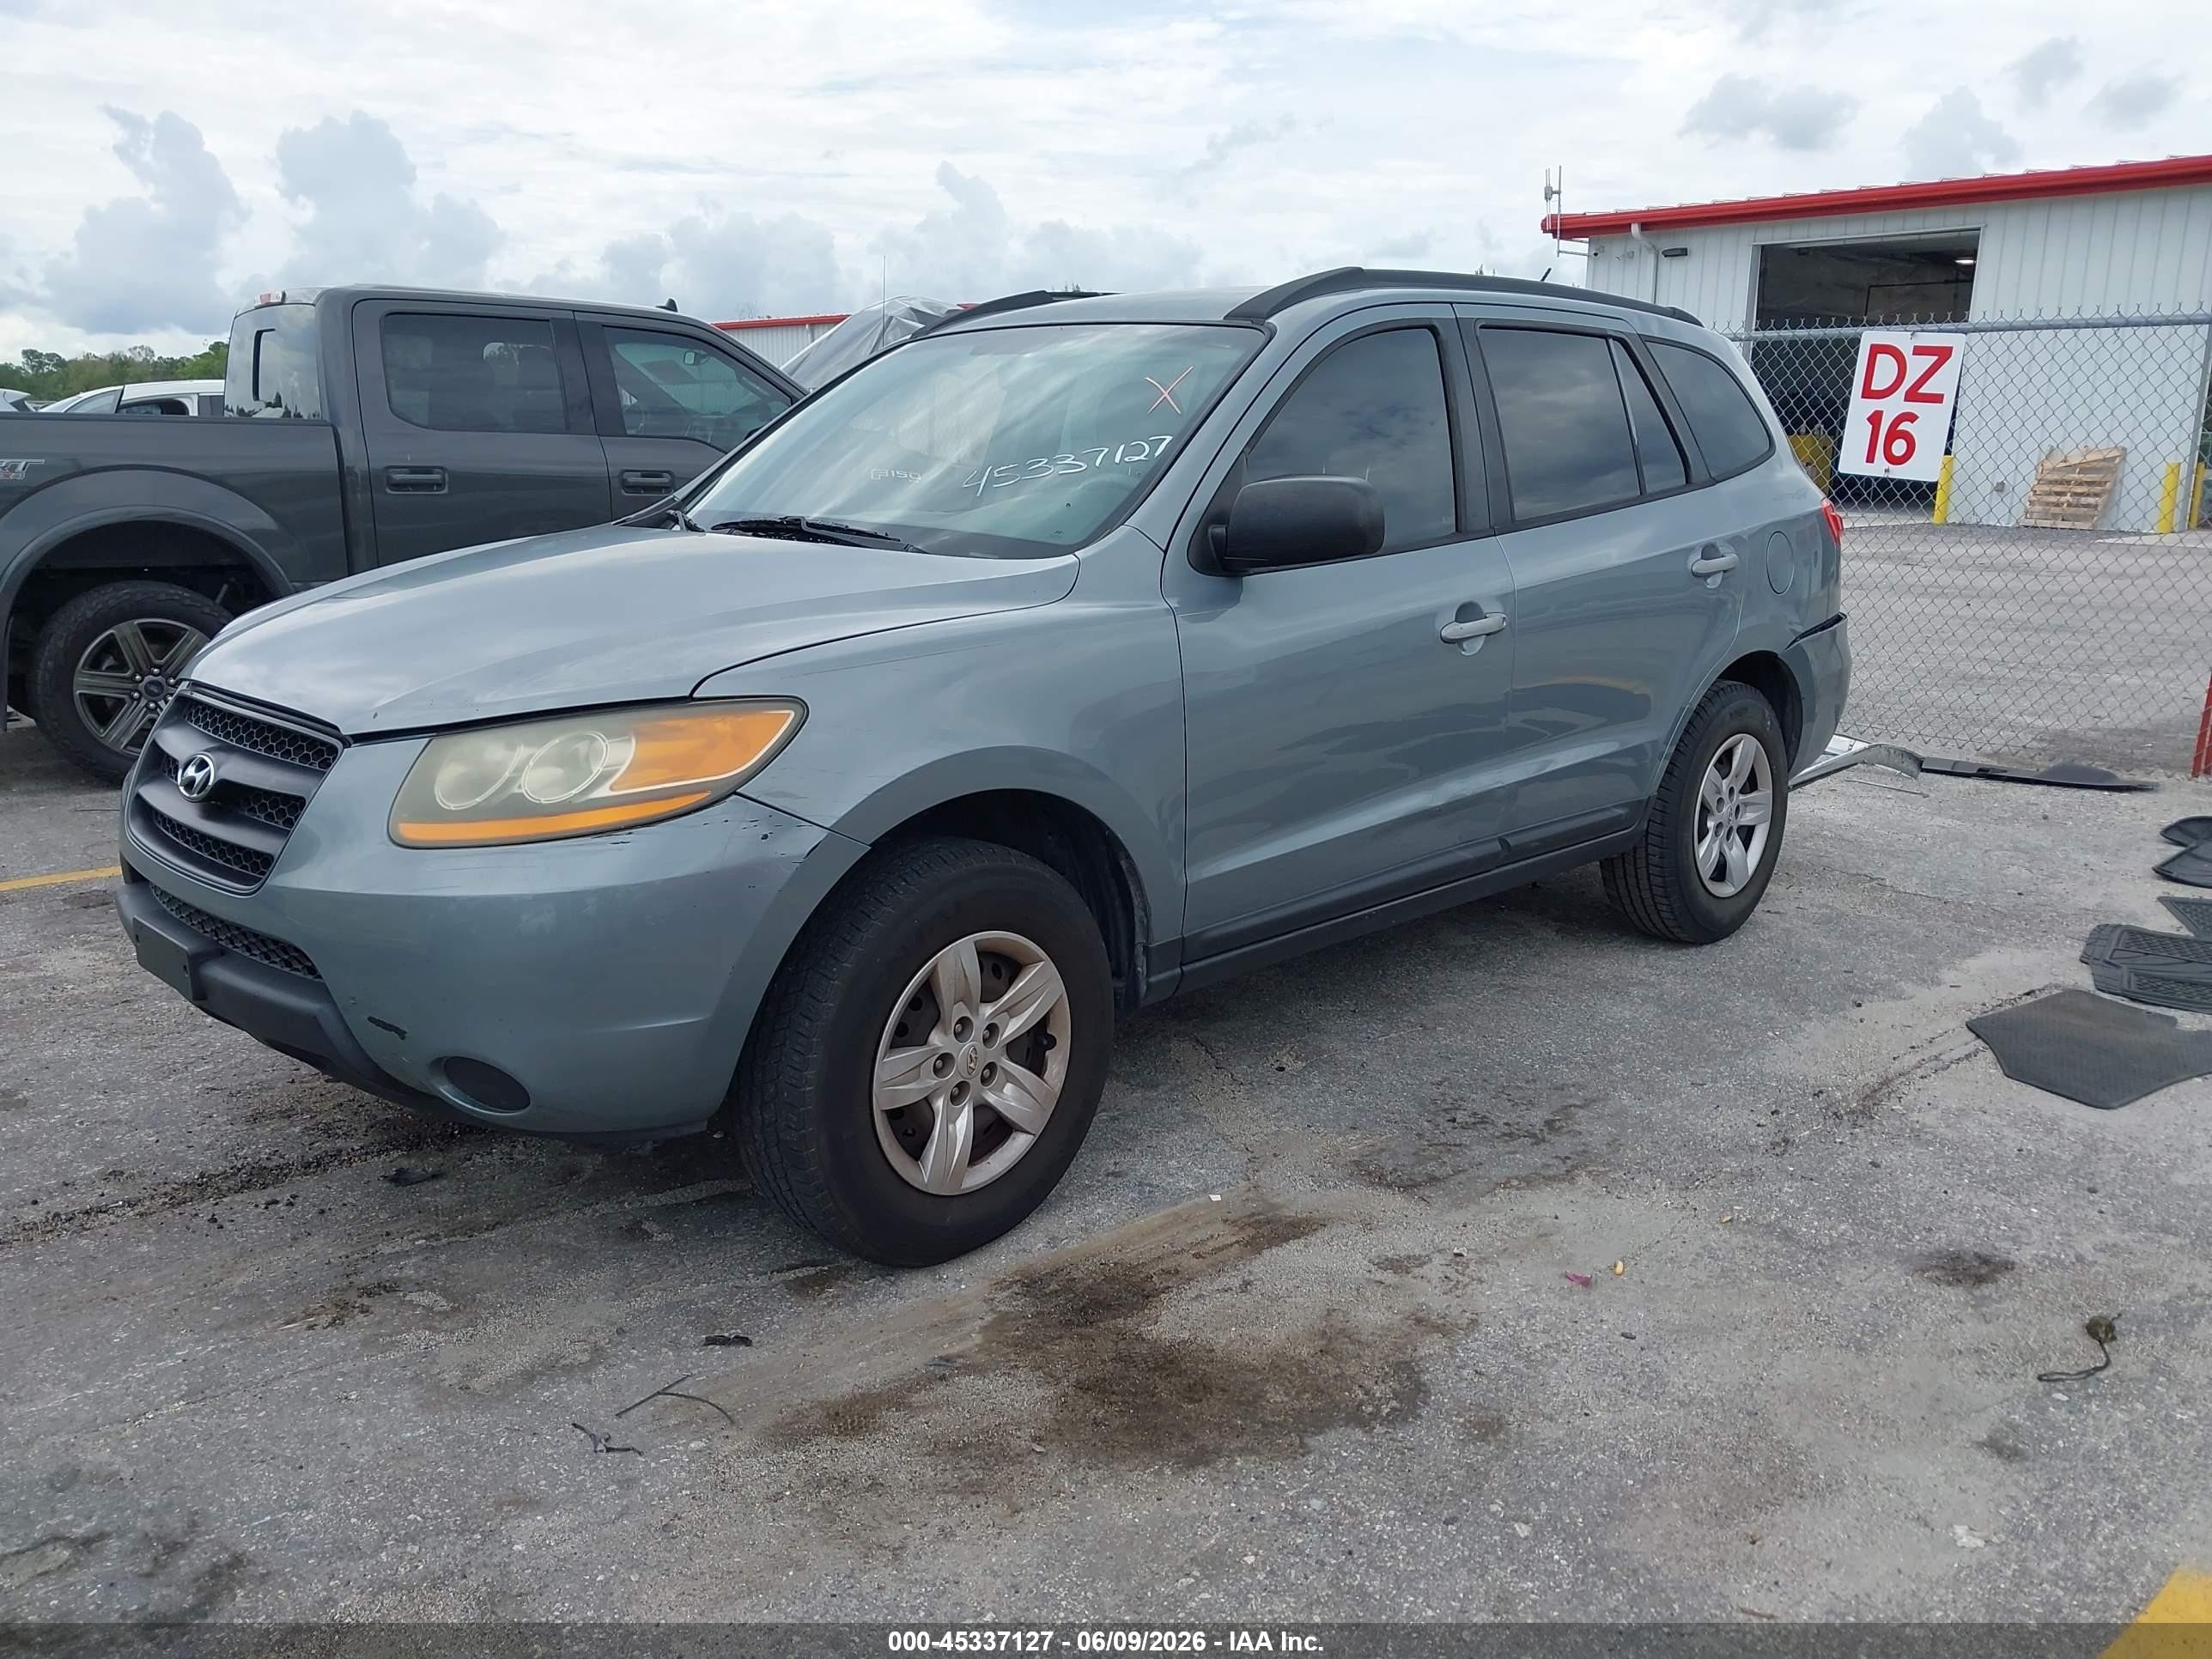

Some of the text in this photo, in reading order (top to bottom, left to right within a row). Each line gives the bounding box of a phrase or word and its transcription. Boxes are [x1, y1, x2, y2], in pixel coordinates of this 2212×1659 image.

[1861, 343, 1954, 404] DZ
[962, 434, 1174, 497] 45337127
[1865, 410, 1920, 466] 16
